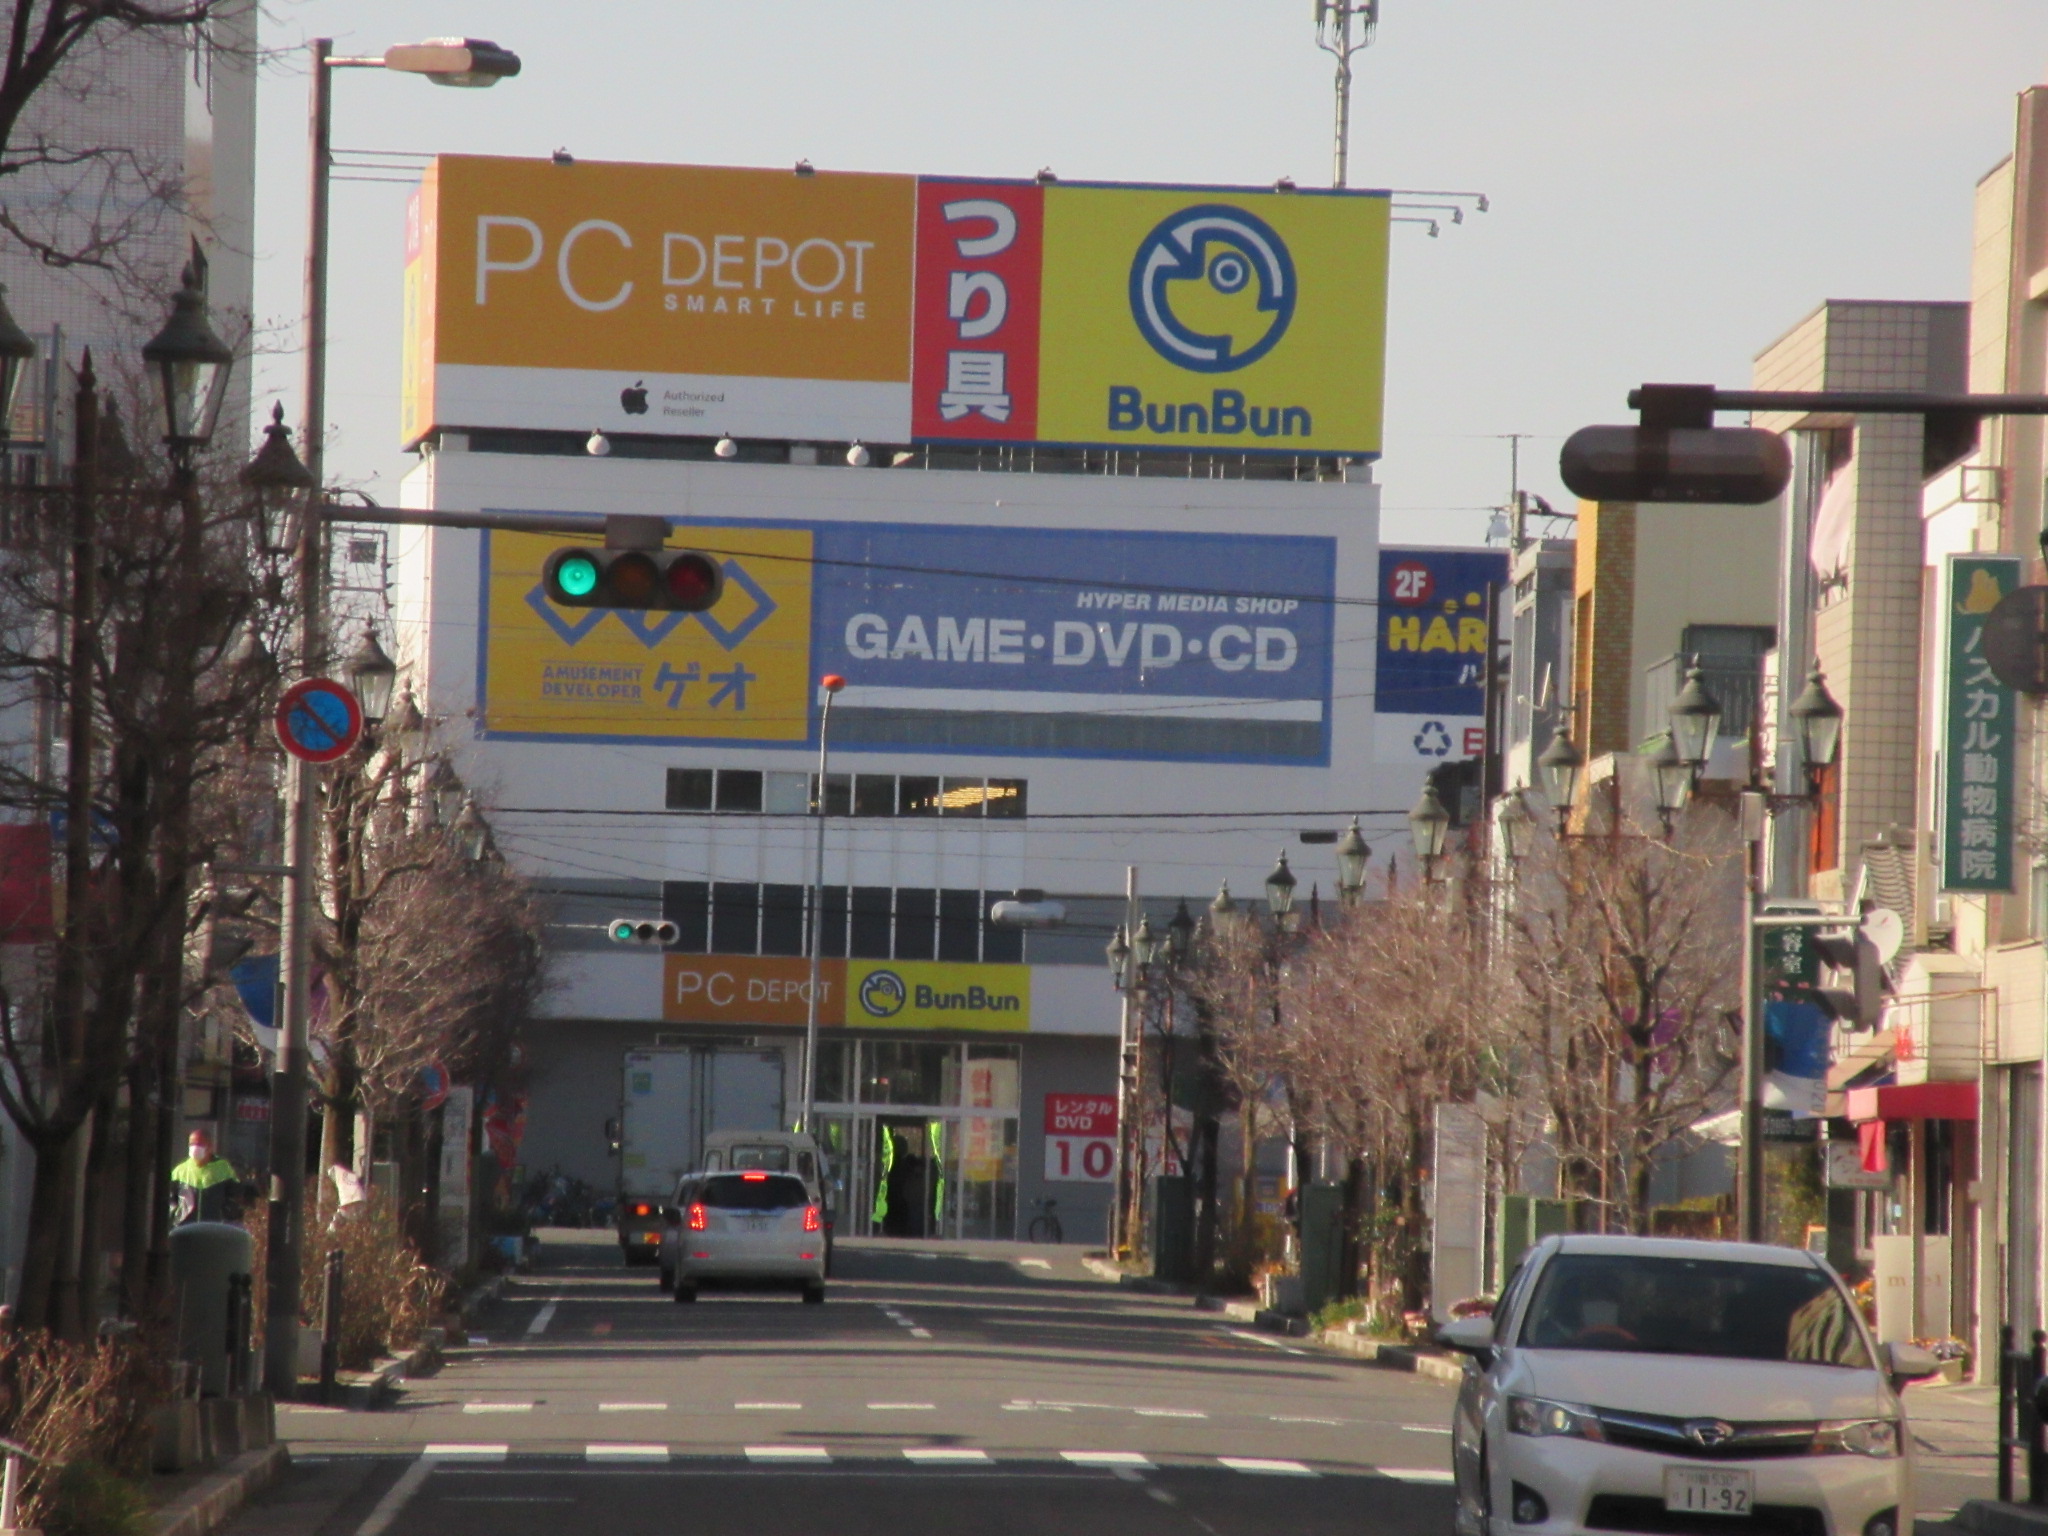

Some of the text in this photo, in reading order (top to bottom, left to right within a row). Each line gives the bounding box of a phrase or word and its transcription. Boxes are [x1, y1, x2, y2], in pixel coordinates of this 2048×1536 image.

[476, 214, 633, 312] PC
[662, 232, 875, 293] DEPOT
[664, 294, 866, 319] SMART LIFE
[940, 199, 1017, 423] つり具
[663, 390, 725, 403] Authorized
[663, 406, 705, 417] Reseller
[1108, 385, 1312, 437] BunBun
[1395, 570, 1427, 598] 2F
[1077, 592, 1299, 615] HYPER MEDIA SHOP
[542, 665, 644, 682] AMUSEMENT
[653, 661, 757, 711] ゲオ
[542, 681, 642, 698] DEVELOPER
[677, 971, 832, 1006] PC DEPOT
[915, 985, 1020, 1011] BunBun
[1055, 1100, 1113, 1115] レンタル
[1055, 1115, 1093, 1130] DVD
